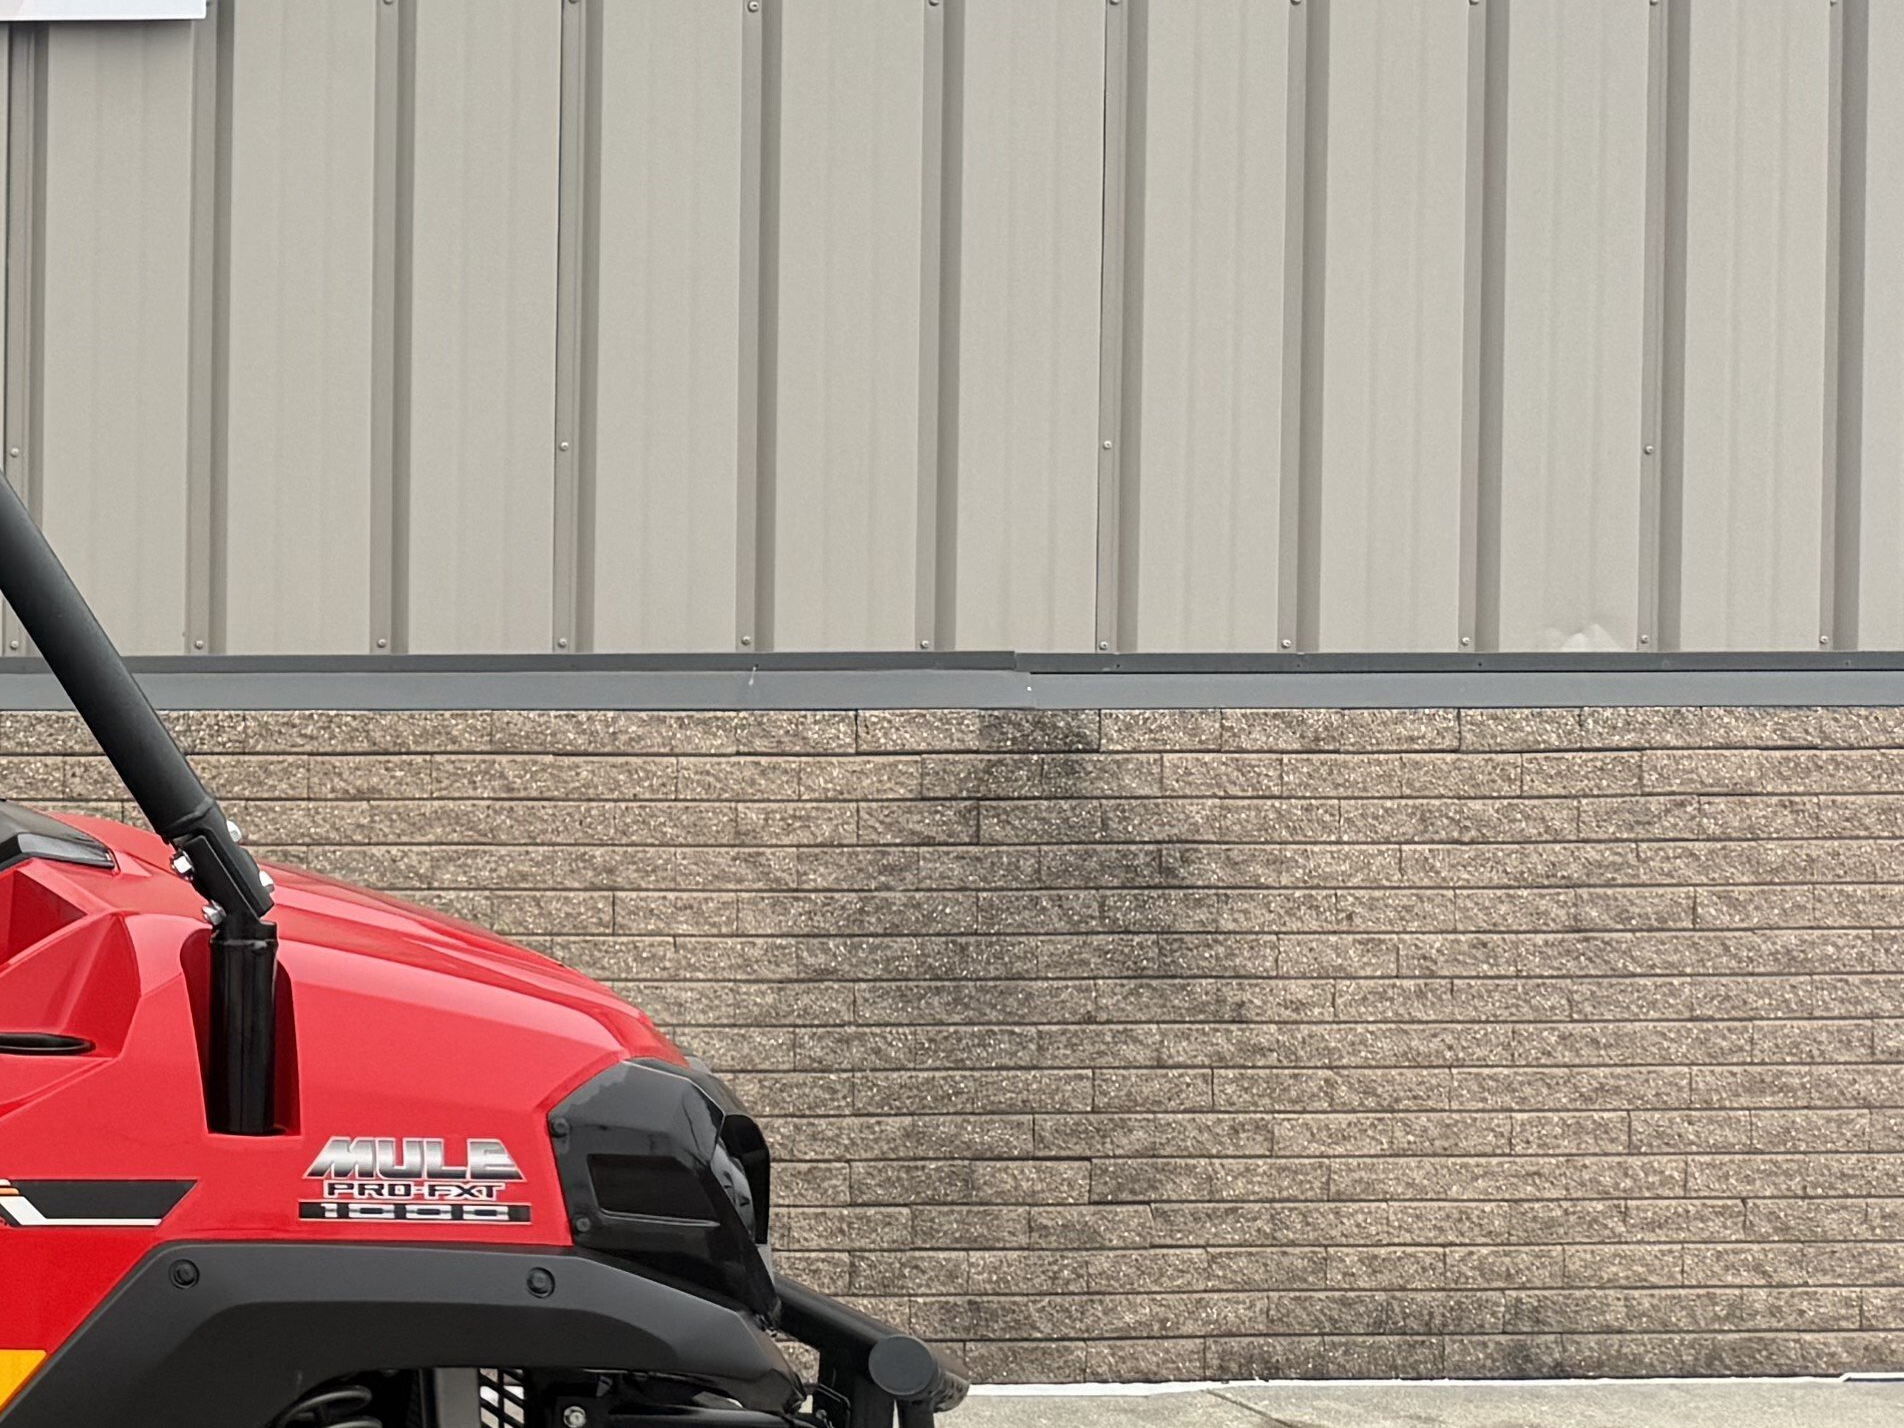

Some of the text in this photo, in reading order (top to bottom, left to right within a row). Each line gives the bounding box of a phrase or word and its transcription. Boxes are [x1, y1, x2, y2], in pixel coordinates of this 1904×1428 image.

[303, 1136, 527, 1181] MULE
[324, 1180, 506, 1201] PRO-FXT
[319, 1202, 511, 1221] 1000
